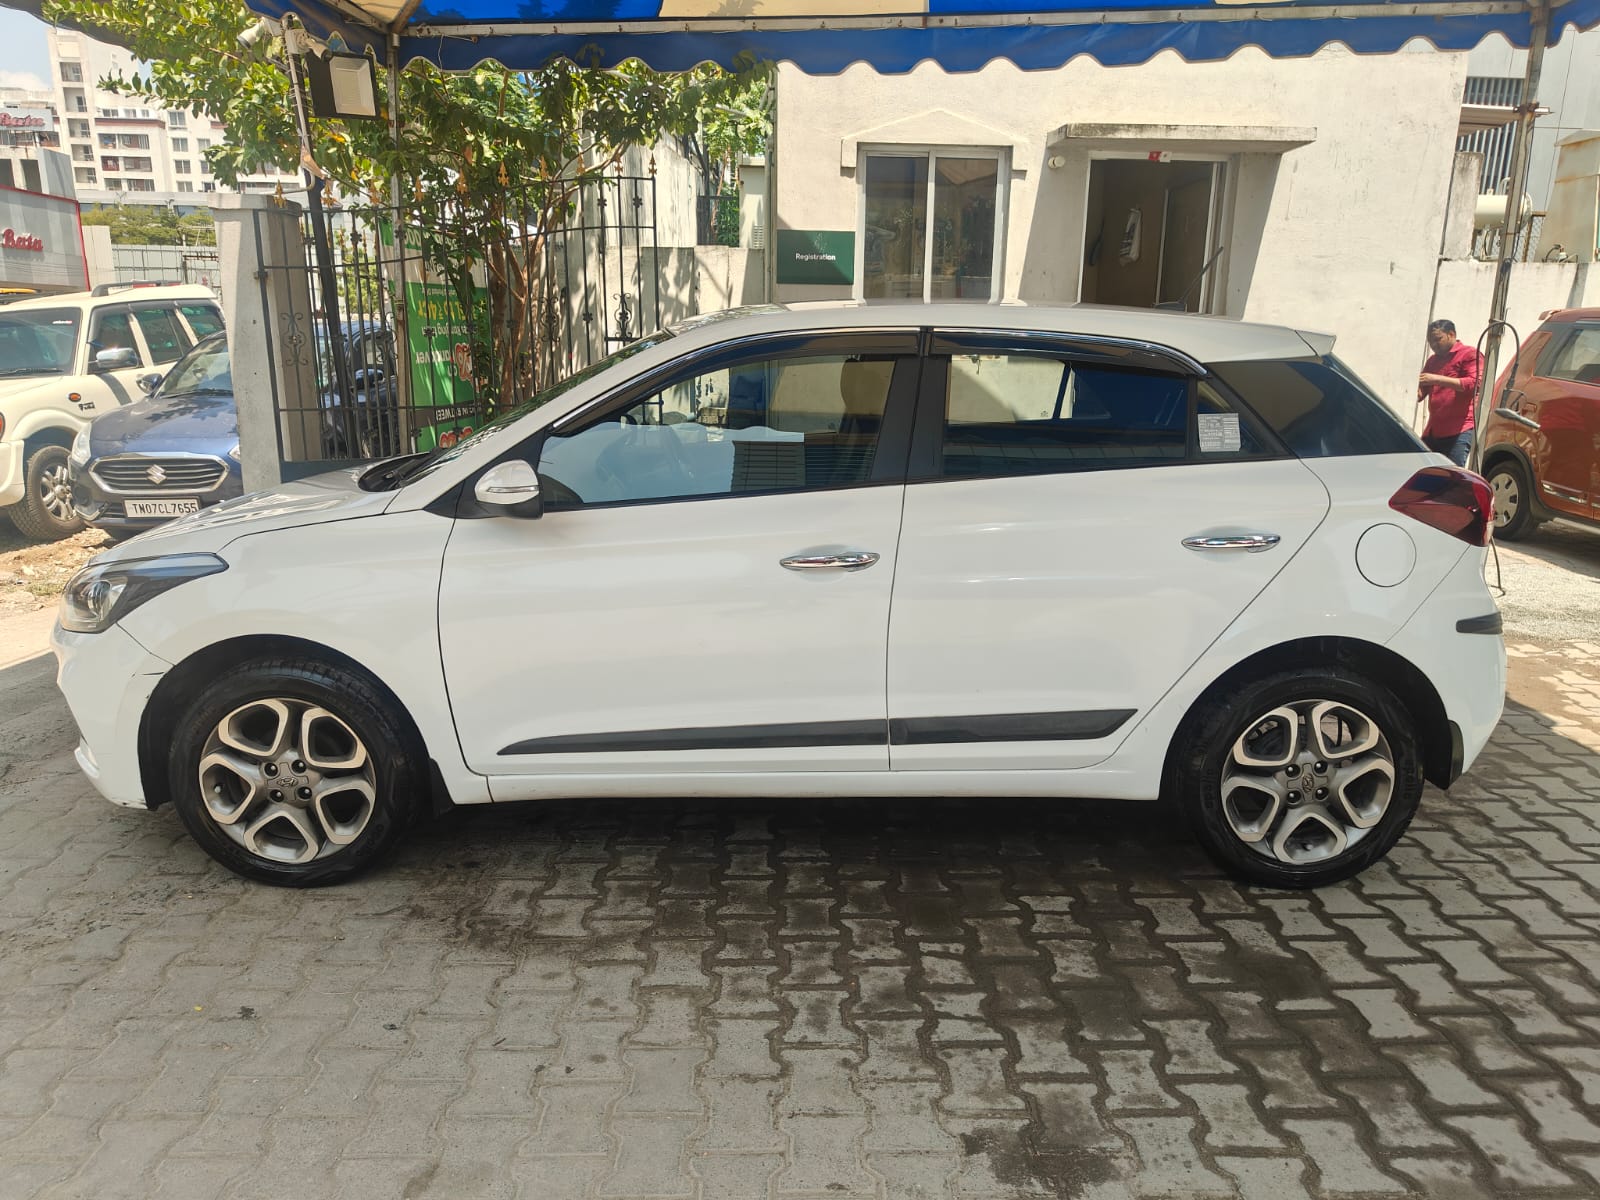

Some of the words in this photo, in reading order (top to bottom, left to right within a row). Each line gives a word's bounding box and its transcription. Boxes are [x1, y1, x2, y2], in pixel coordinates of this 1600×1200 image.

[0, 112, 44, 127] Bata
[3, 229, 43, 252] Bata
[795, 253, 836, 261] Registration
[132, 503, 198, 514] TN07CL7655
